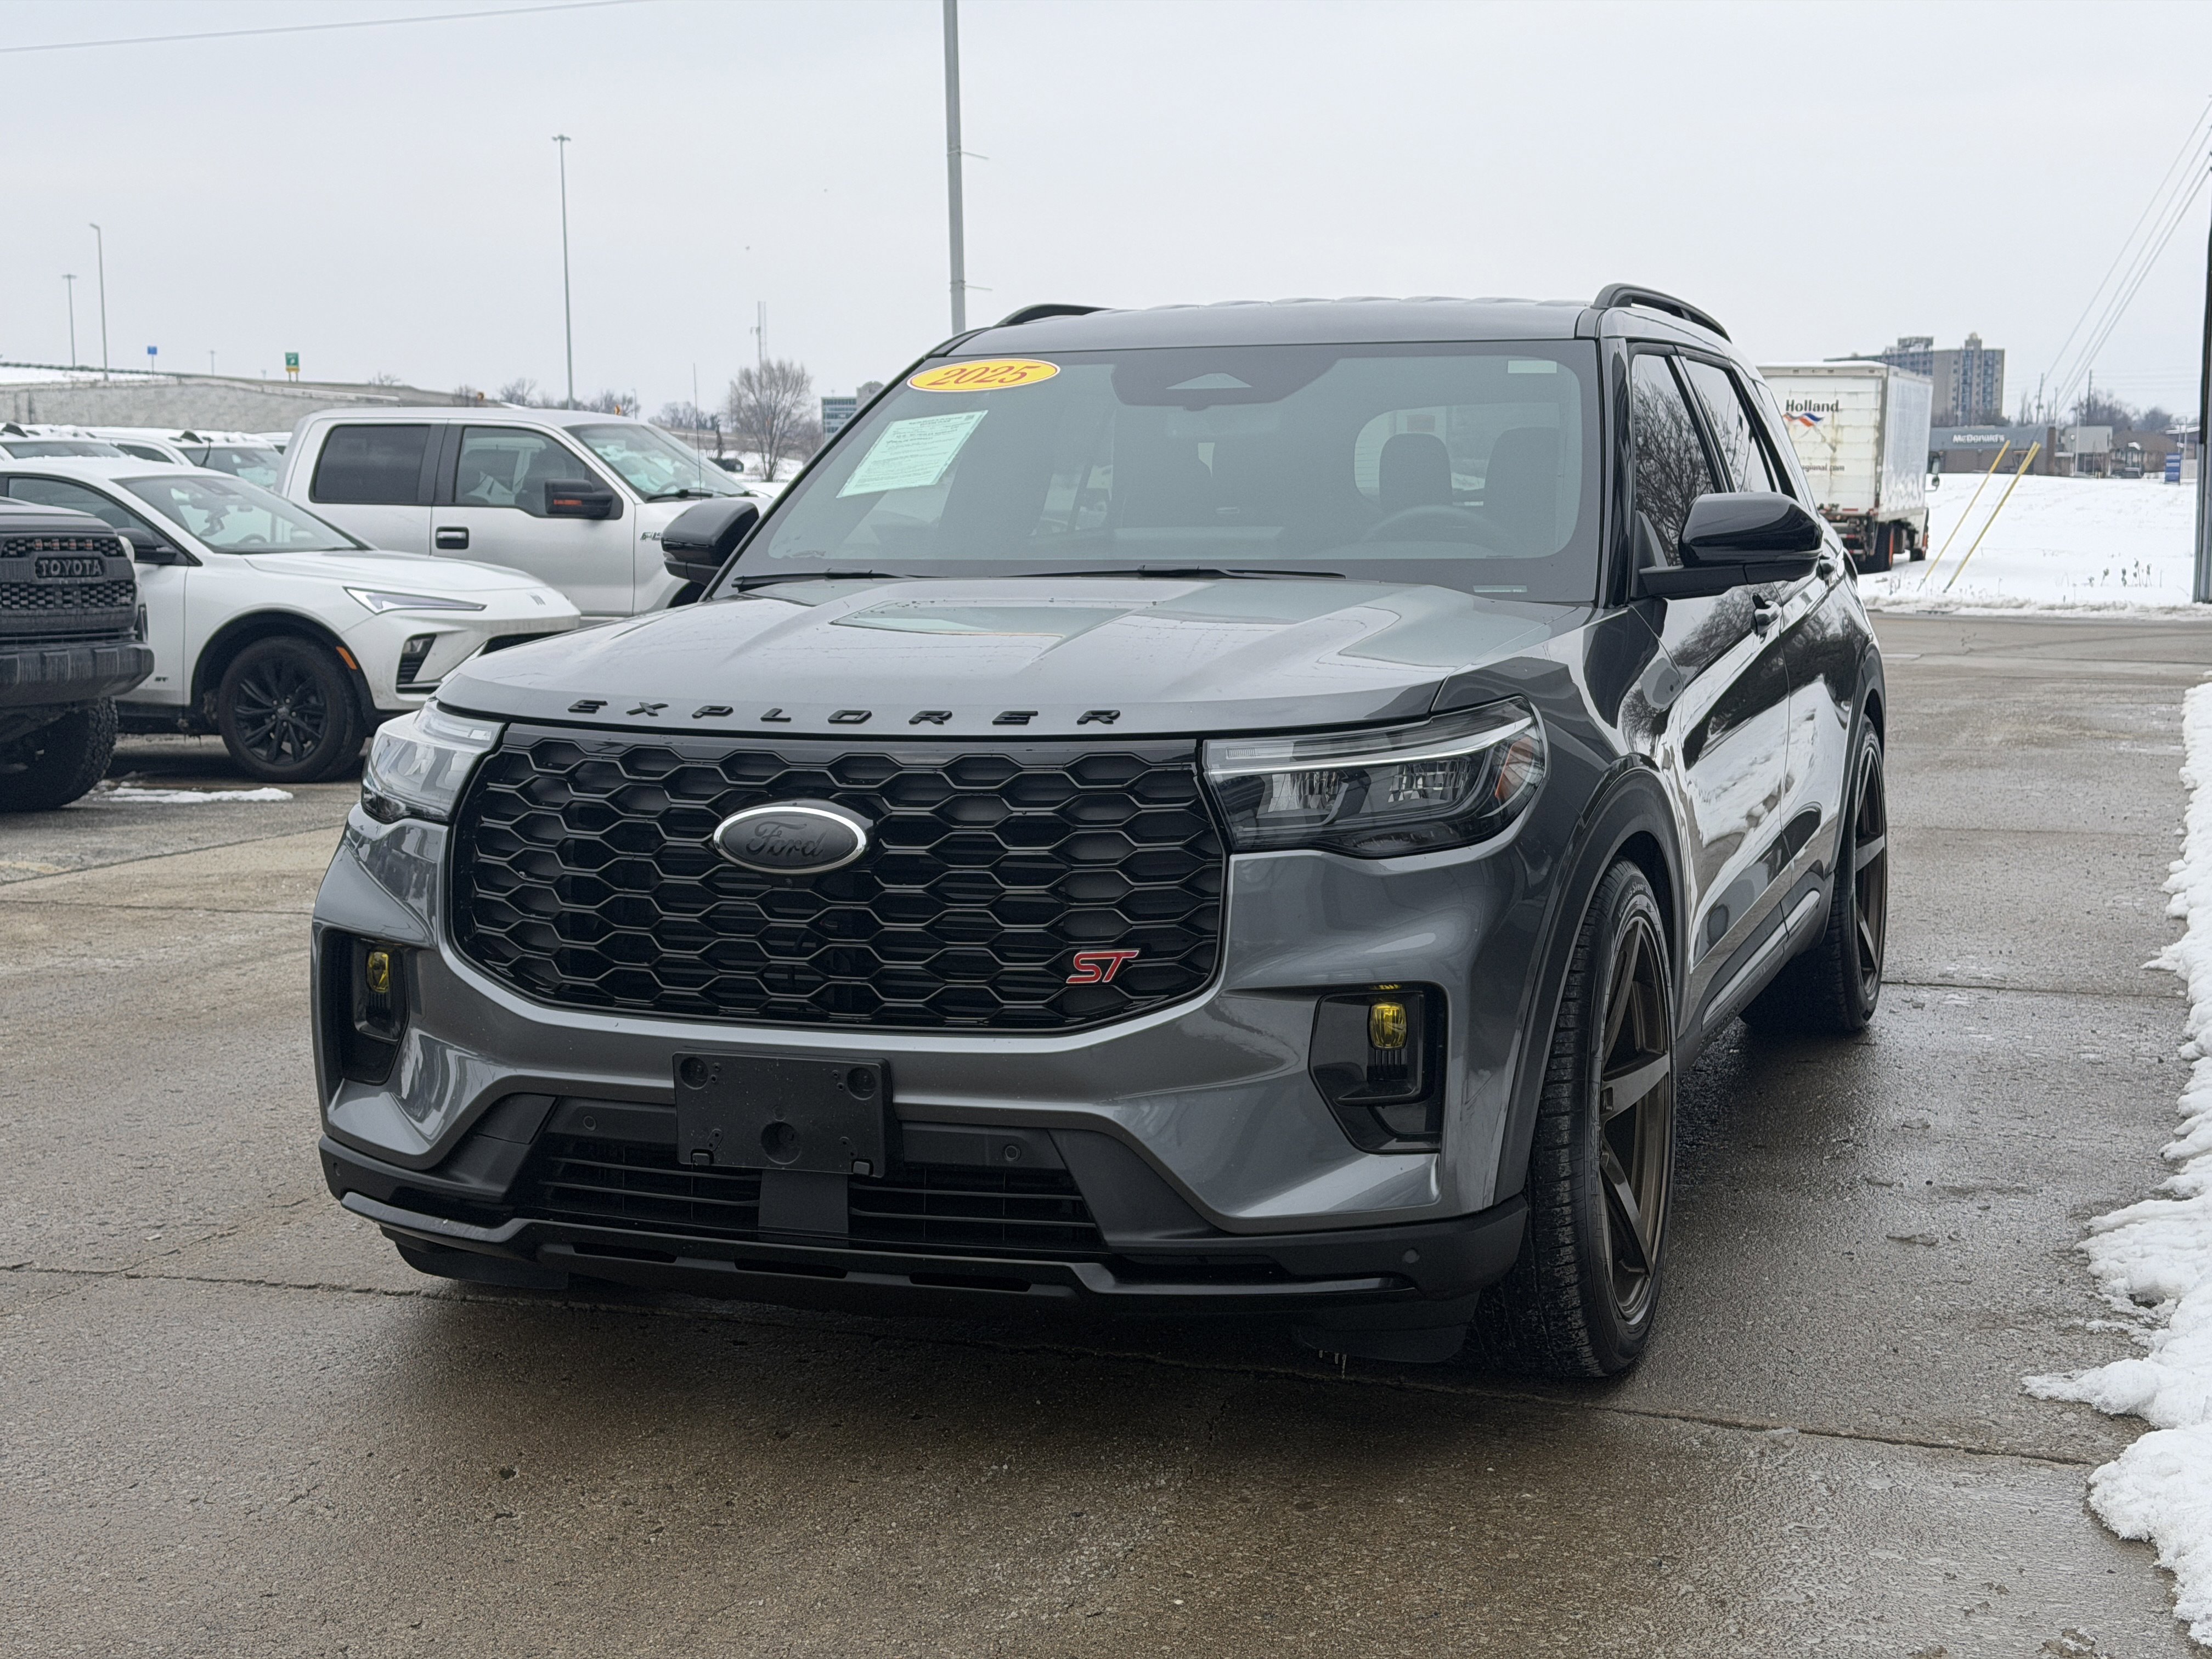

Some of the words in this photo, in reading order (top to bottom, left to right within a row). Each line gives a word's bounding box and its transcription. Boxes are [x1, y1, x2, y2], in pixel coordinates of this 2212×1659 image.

[926, 365, 1041, 386] 2025
[1785, 399, 1839, 411] Holland
[40, 560, 102, 576] TOYOTA
[567, 699, 1120, 725] EXPLORER
[746, 821, 826, 857] Ford
[1065, 950, 1140, 984] ST
